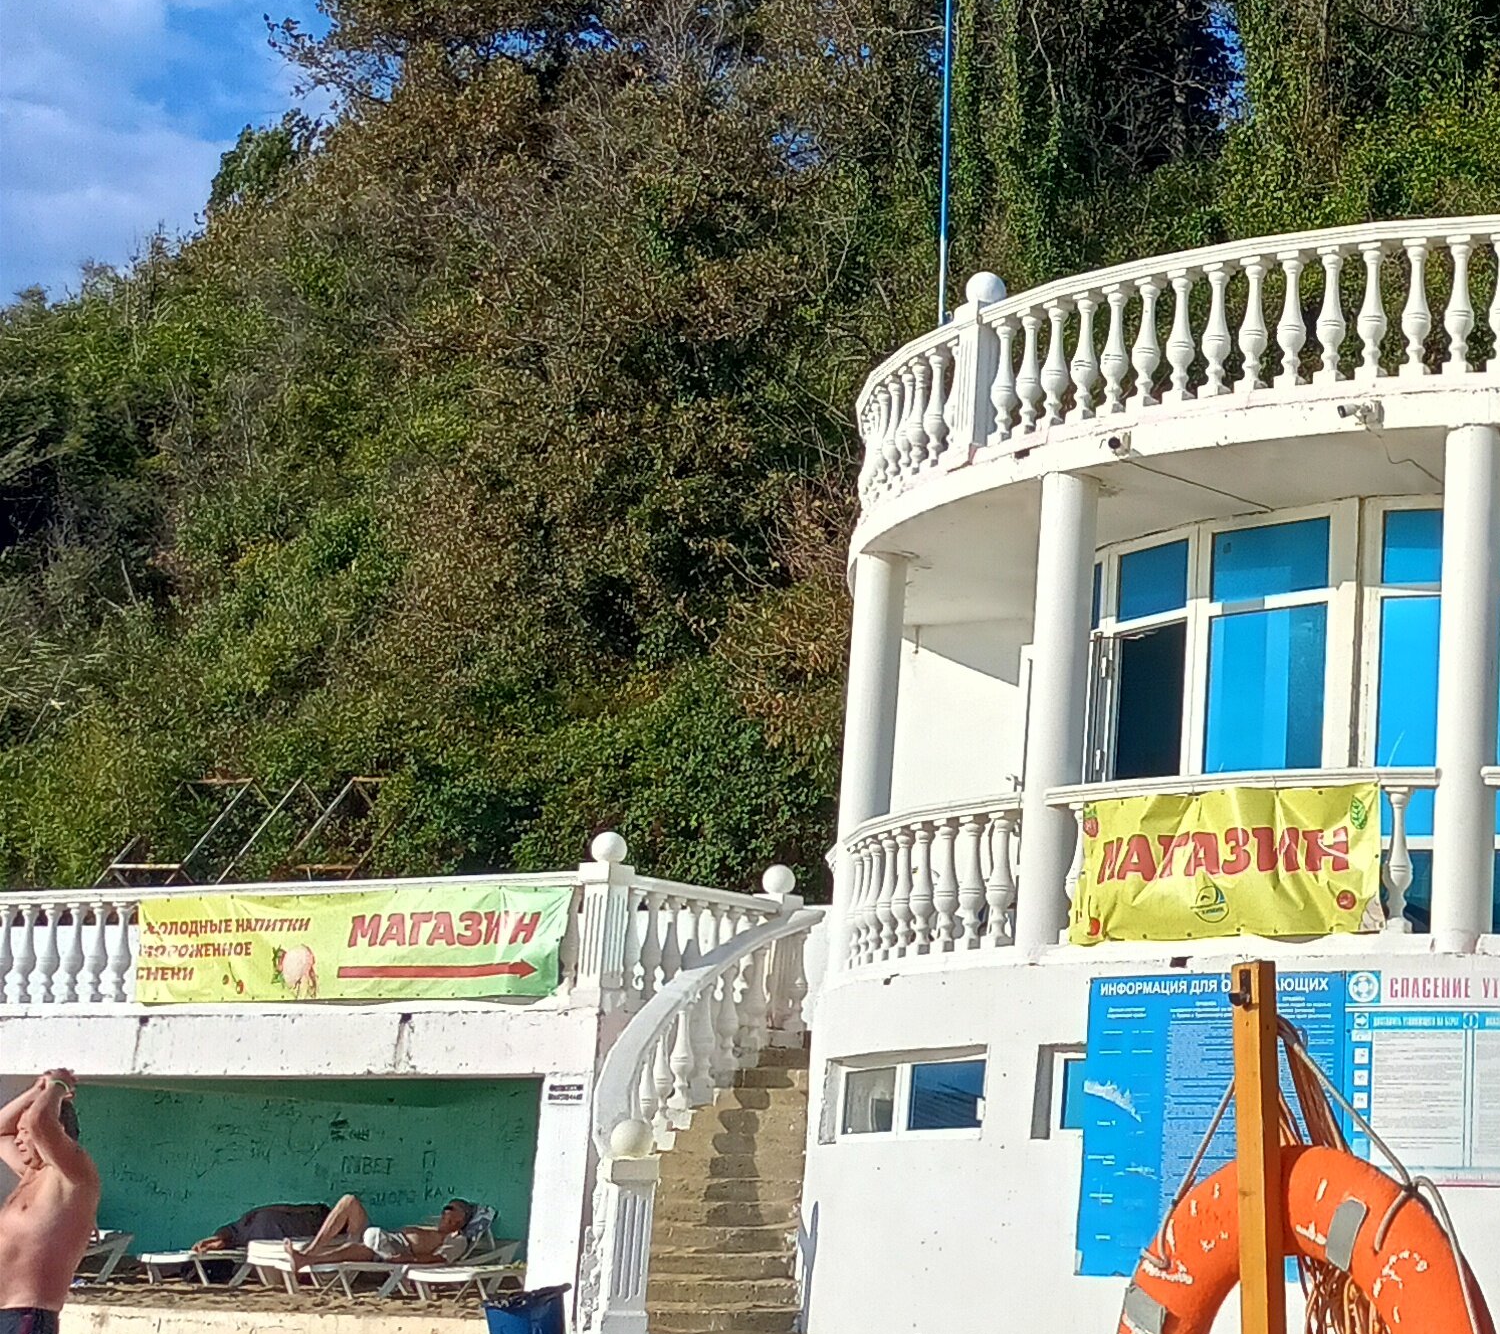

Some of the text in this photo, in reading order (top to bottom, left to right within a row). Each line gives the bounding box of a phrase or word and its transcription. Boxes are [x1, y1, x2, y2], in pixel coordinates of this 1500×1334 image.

[235, 917, 311, 933] НАПИТКИ
[348, 911, 542, 948] МАГАЗИН
[1100, 980, 1187, 996] ИНФОРМАЦИЯ
[1190, 979, 1218, 995] ДЛЯ
[1390, 977, 1471, 999] СПАСЕНИЕ
